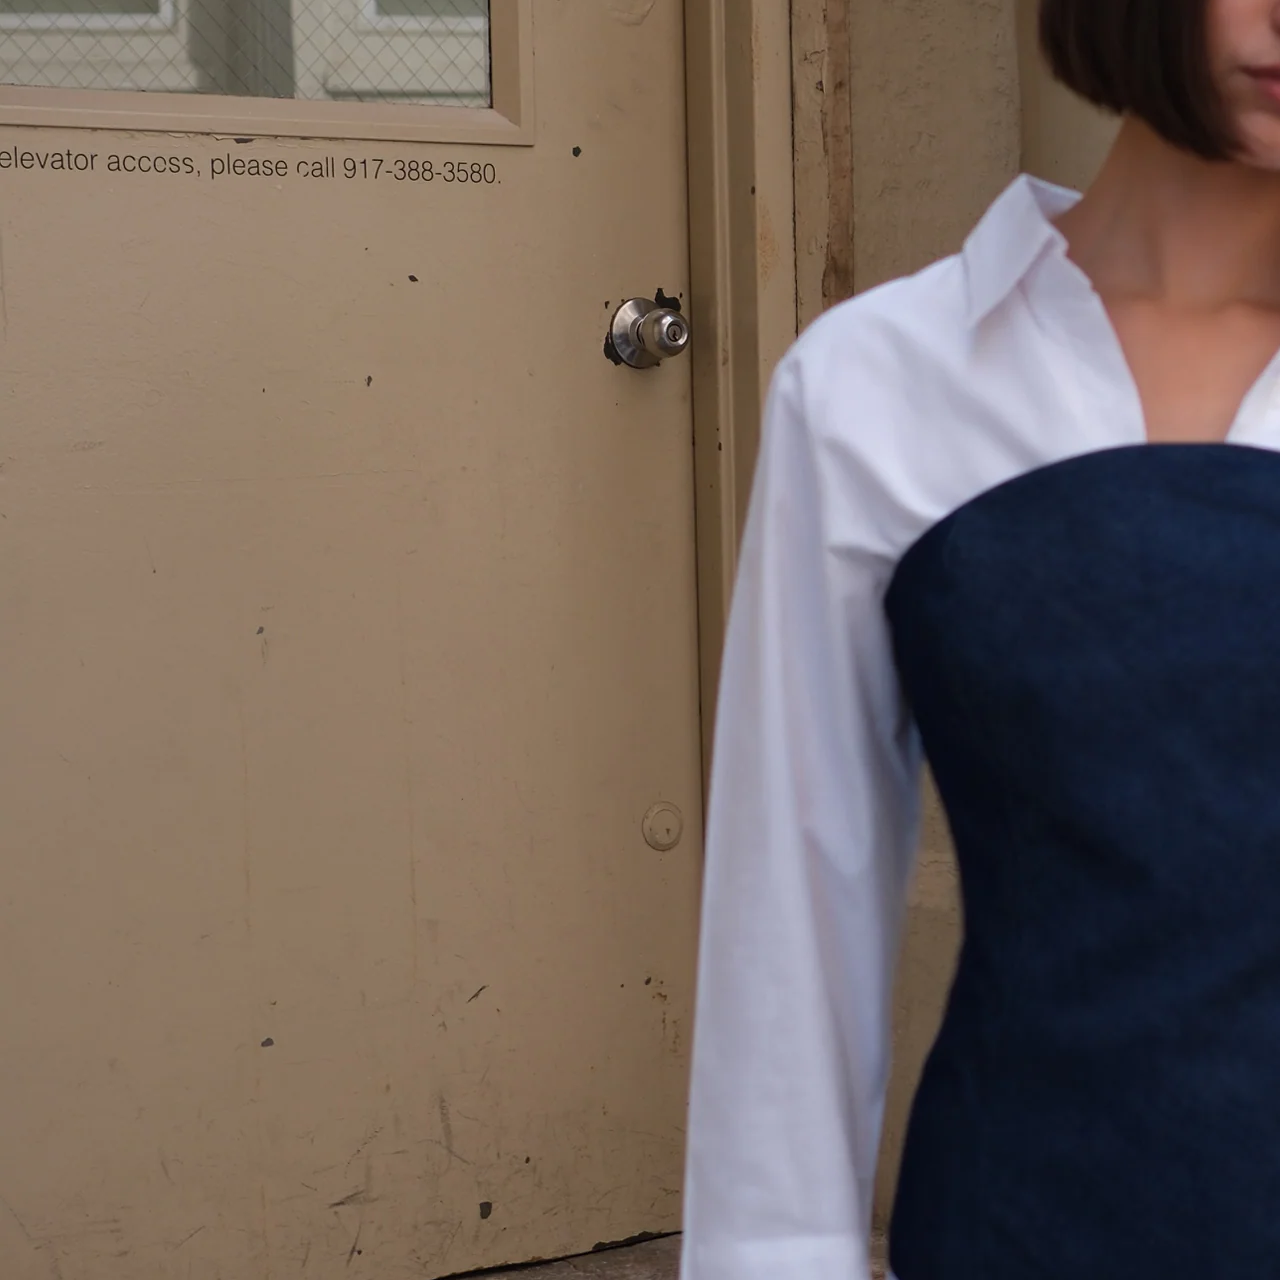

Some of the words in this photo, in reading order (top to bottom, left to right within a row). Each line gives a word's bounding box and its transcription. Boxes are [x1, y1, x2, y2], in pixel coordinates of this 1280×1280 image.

[0, 146, 98, 171] elevator
[210, 153, 288, 180] please
[297, 156, 335, 178] call
[343, 157, 501, 184] 917-388-3580.
